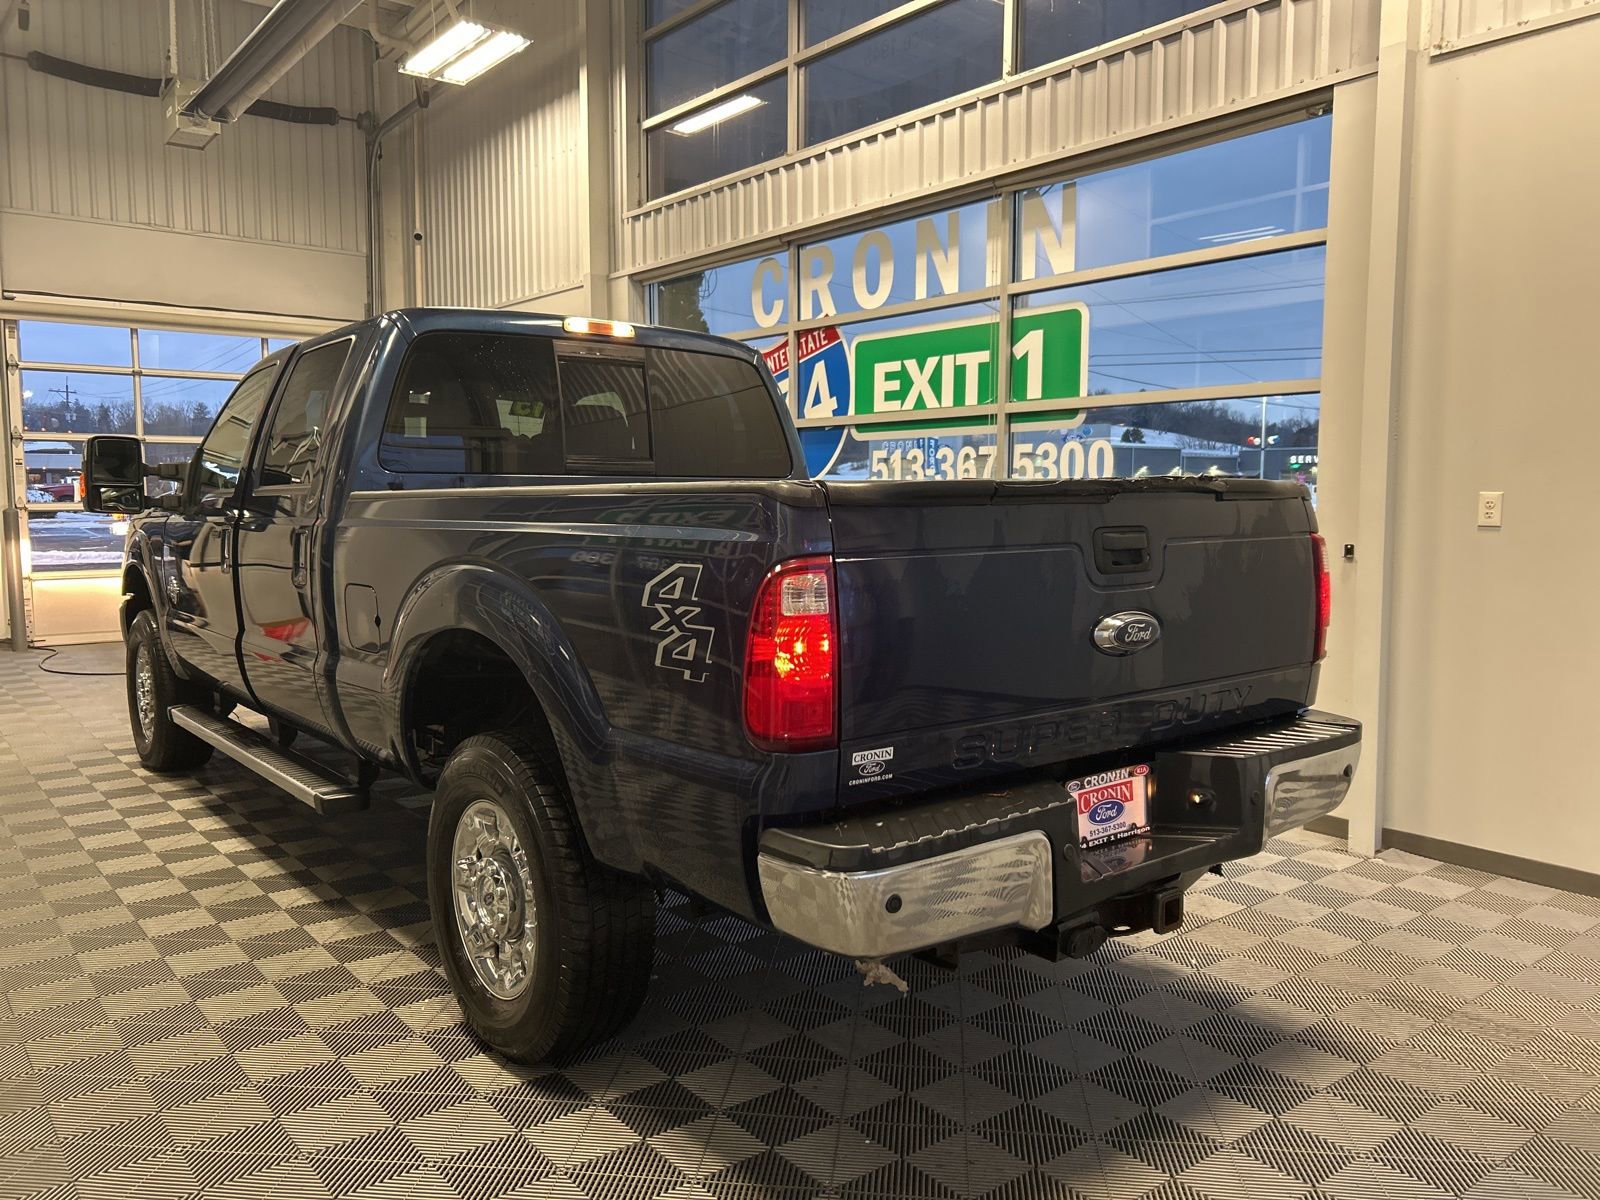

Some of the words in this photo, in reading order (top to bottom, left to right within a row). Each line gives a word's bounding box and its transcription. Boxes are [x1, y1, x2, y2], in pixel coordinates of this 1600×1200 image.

[752, 181, 1076, 328] CRONIN
[874, 350, 990, 412] EXIT
[1012, 329, 1044, 400] 1
[1124, 623, 1152, 643] Ford
[952, 711, 1122, 770] SUPER
[1151, 685, 1254, 732] DUTY
[854, 749, 892, 763] CRONIN
[863, 762, 881, 774] Ford
[1084, 767, 1130, 789] CRONIN
[1081, 783, 1131, 812] CRONIN
[1095, 803, 1118, 821] Ford
[1088, 836, 1109, 848] EXIT
[1117, 825, 1151, 839] Harrison
